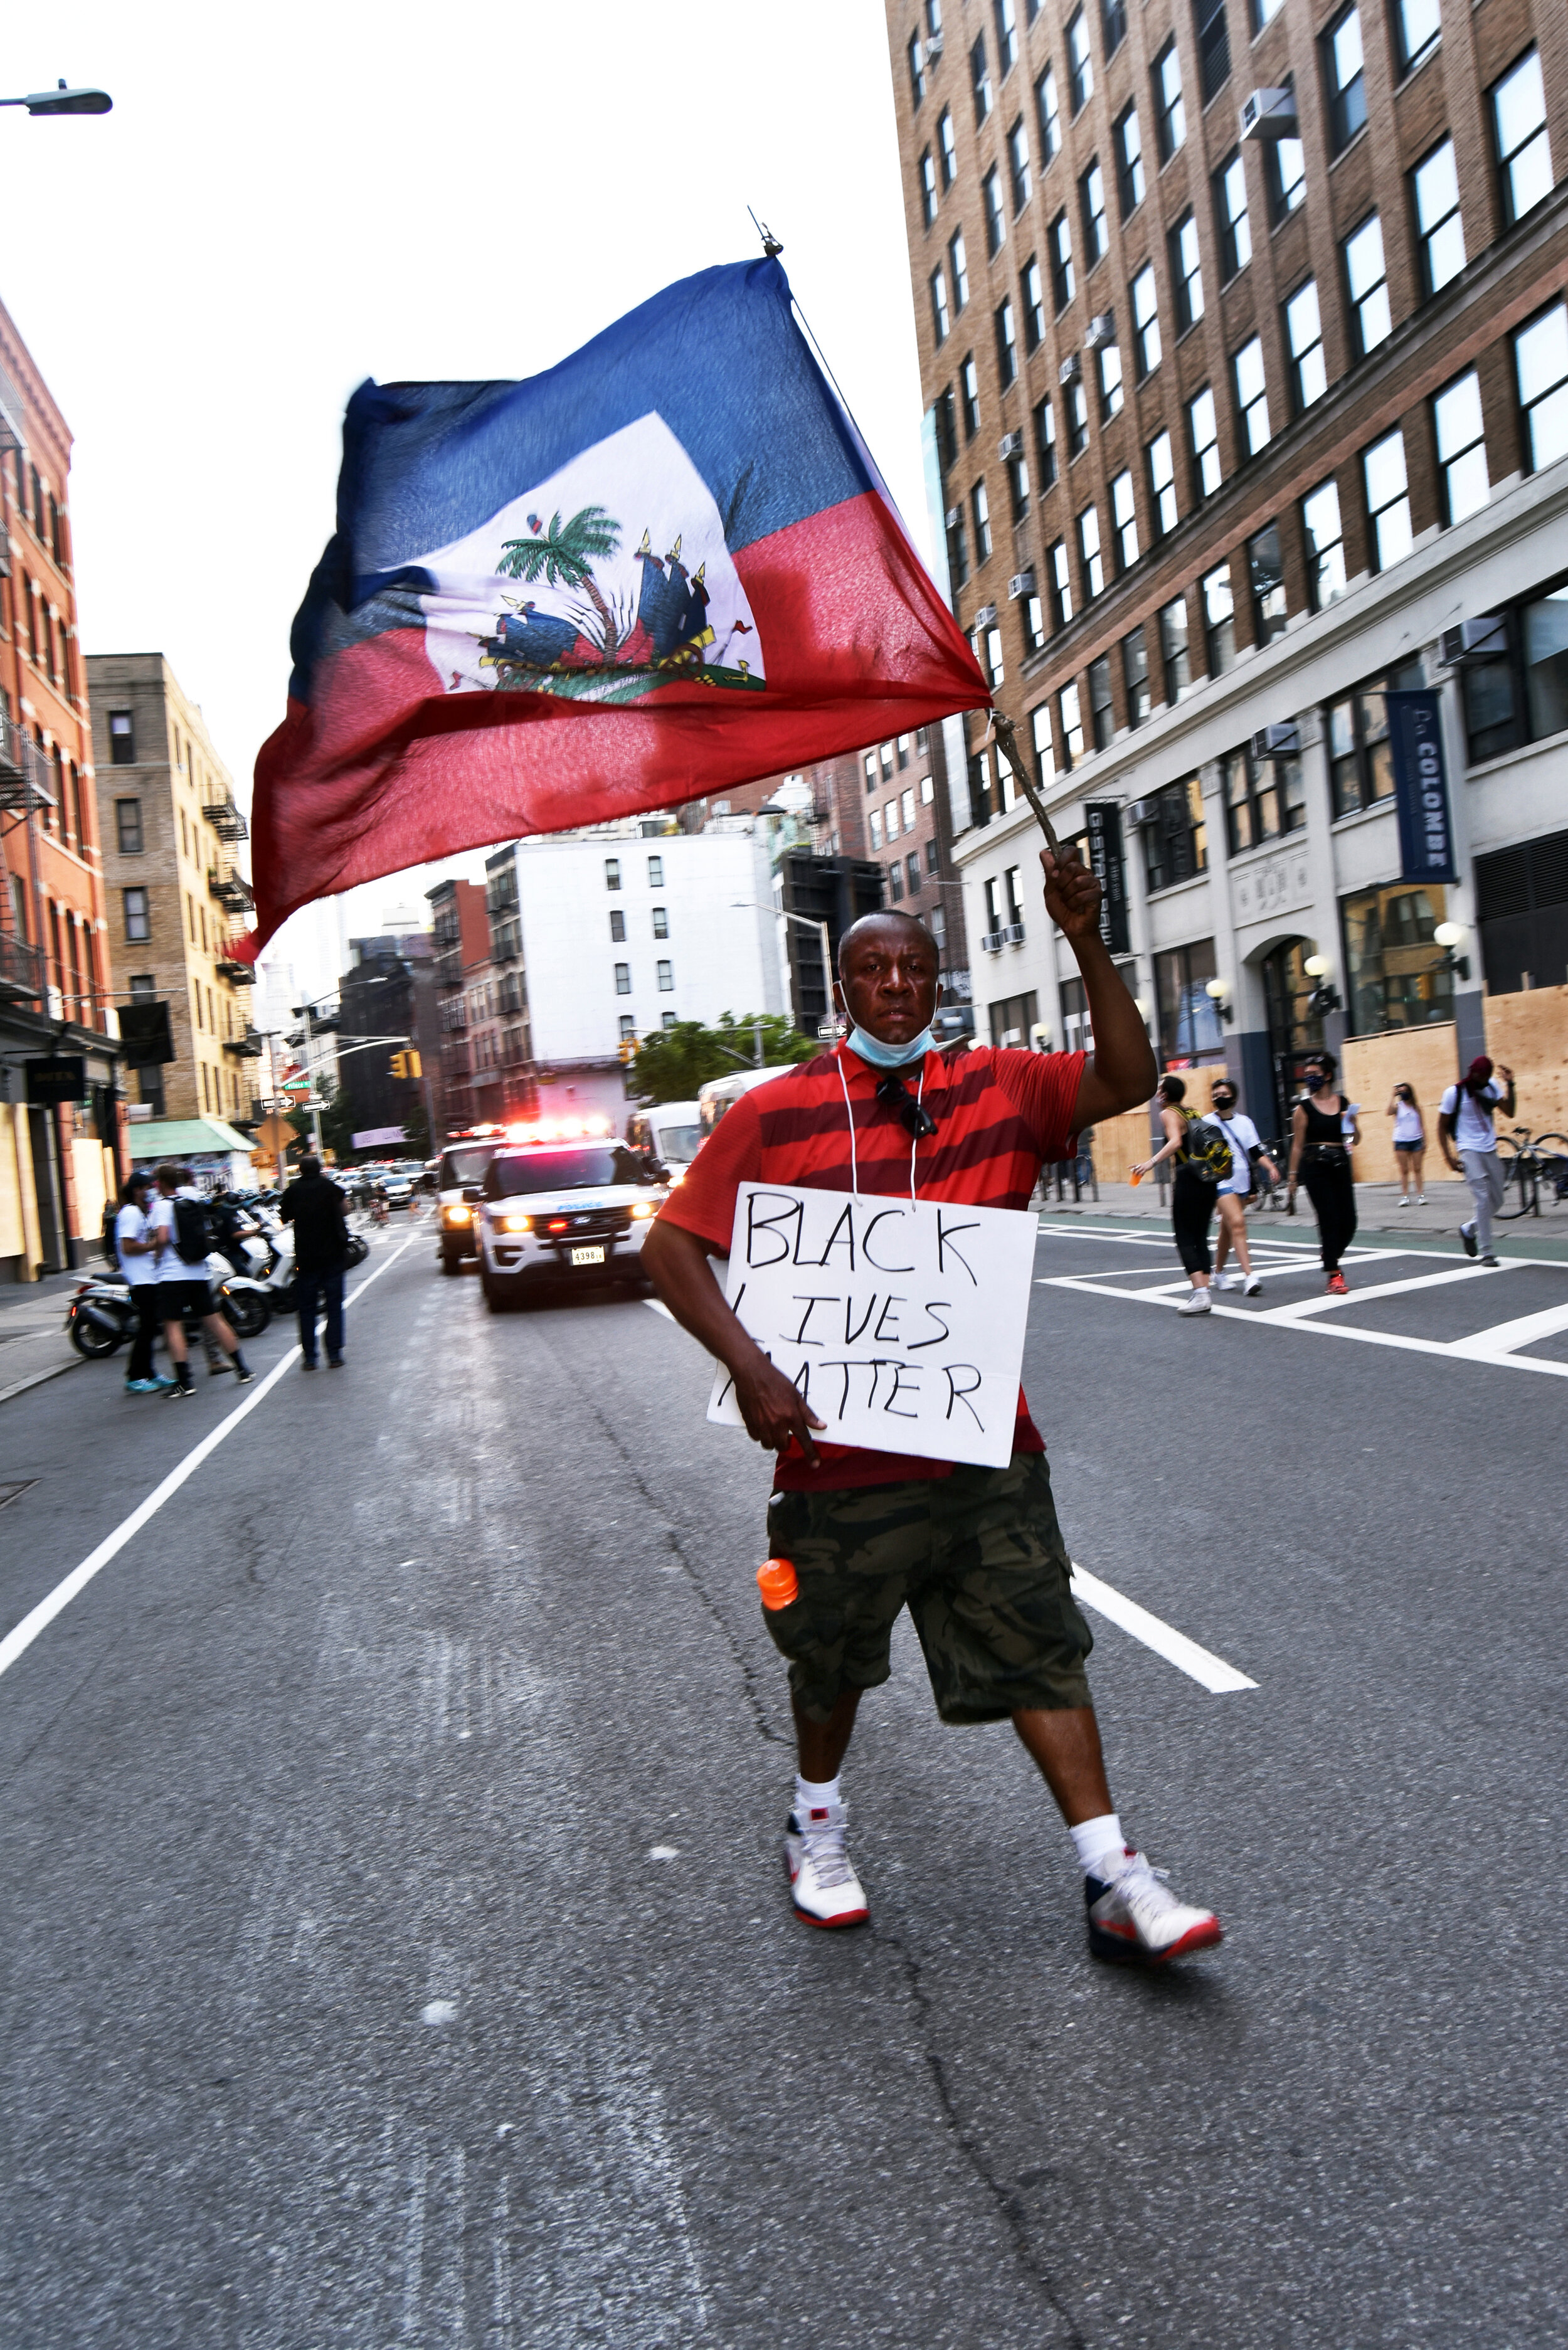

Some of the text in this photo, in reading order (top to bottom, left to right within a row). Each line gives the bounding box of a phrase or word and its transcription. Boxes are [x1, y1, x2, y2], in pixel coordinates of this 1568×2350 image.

[1417, 741, 1448, 868] COLOMBE
[557, 1201, 603, 1212] POLICE
[575, 1251, 595, 1261] 4398
[746, 1191, 981, 1286] BLACK
